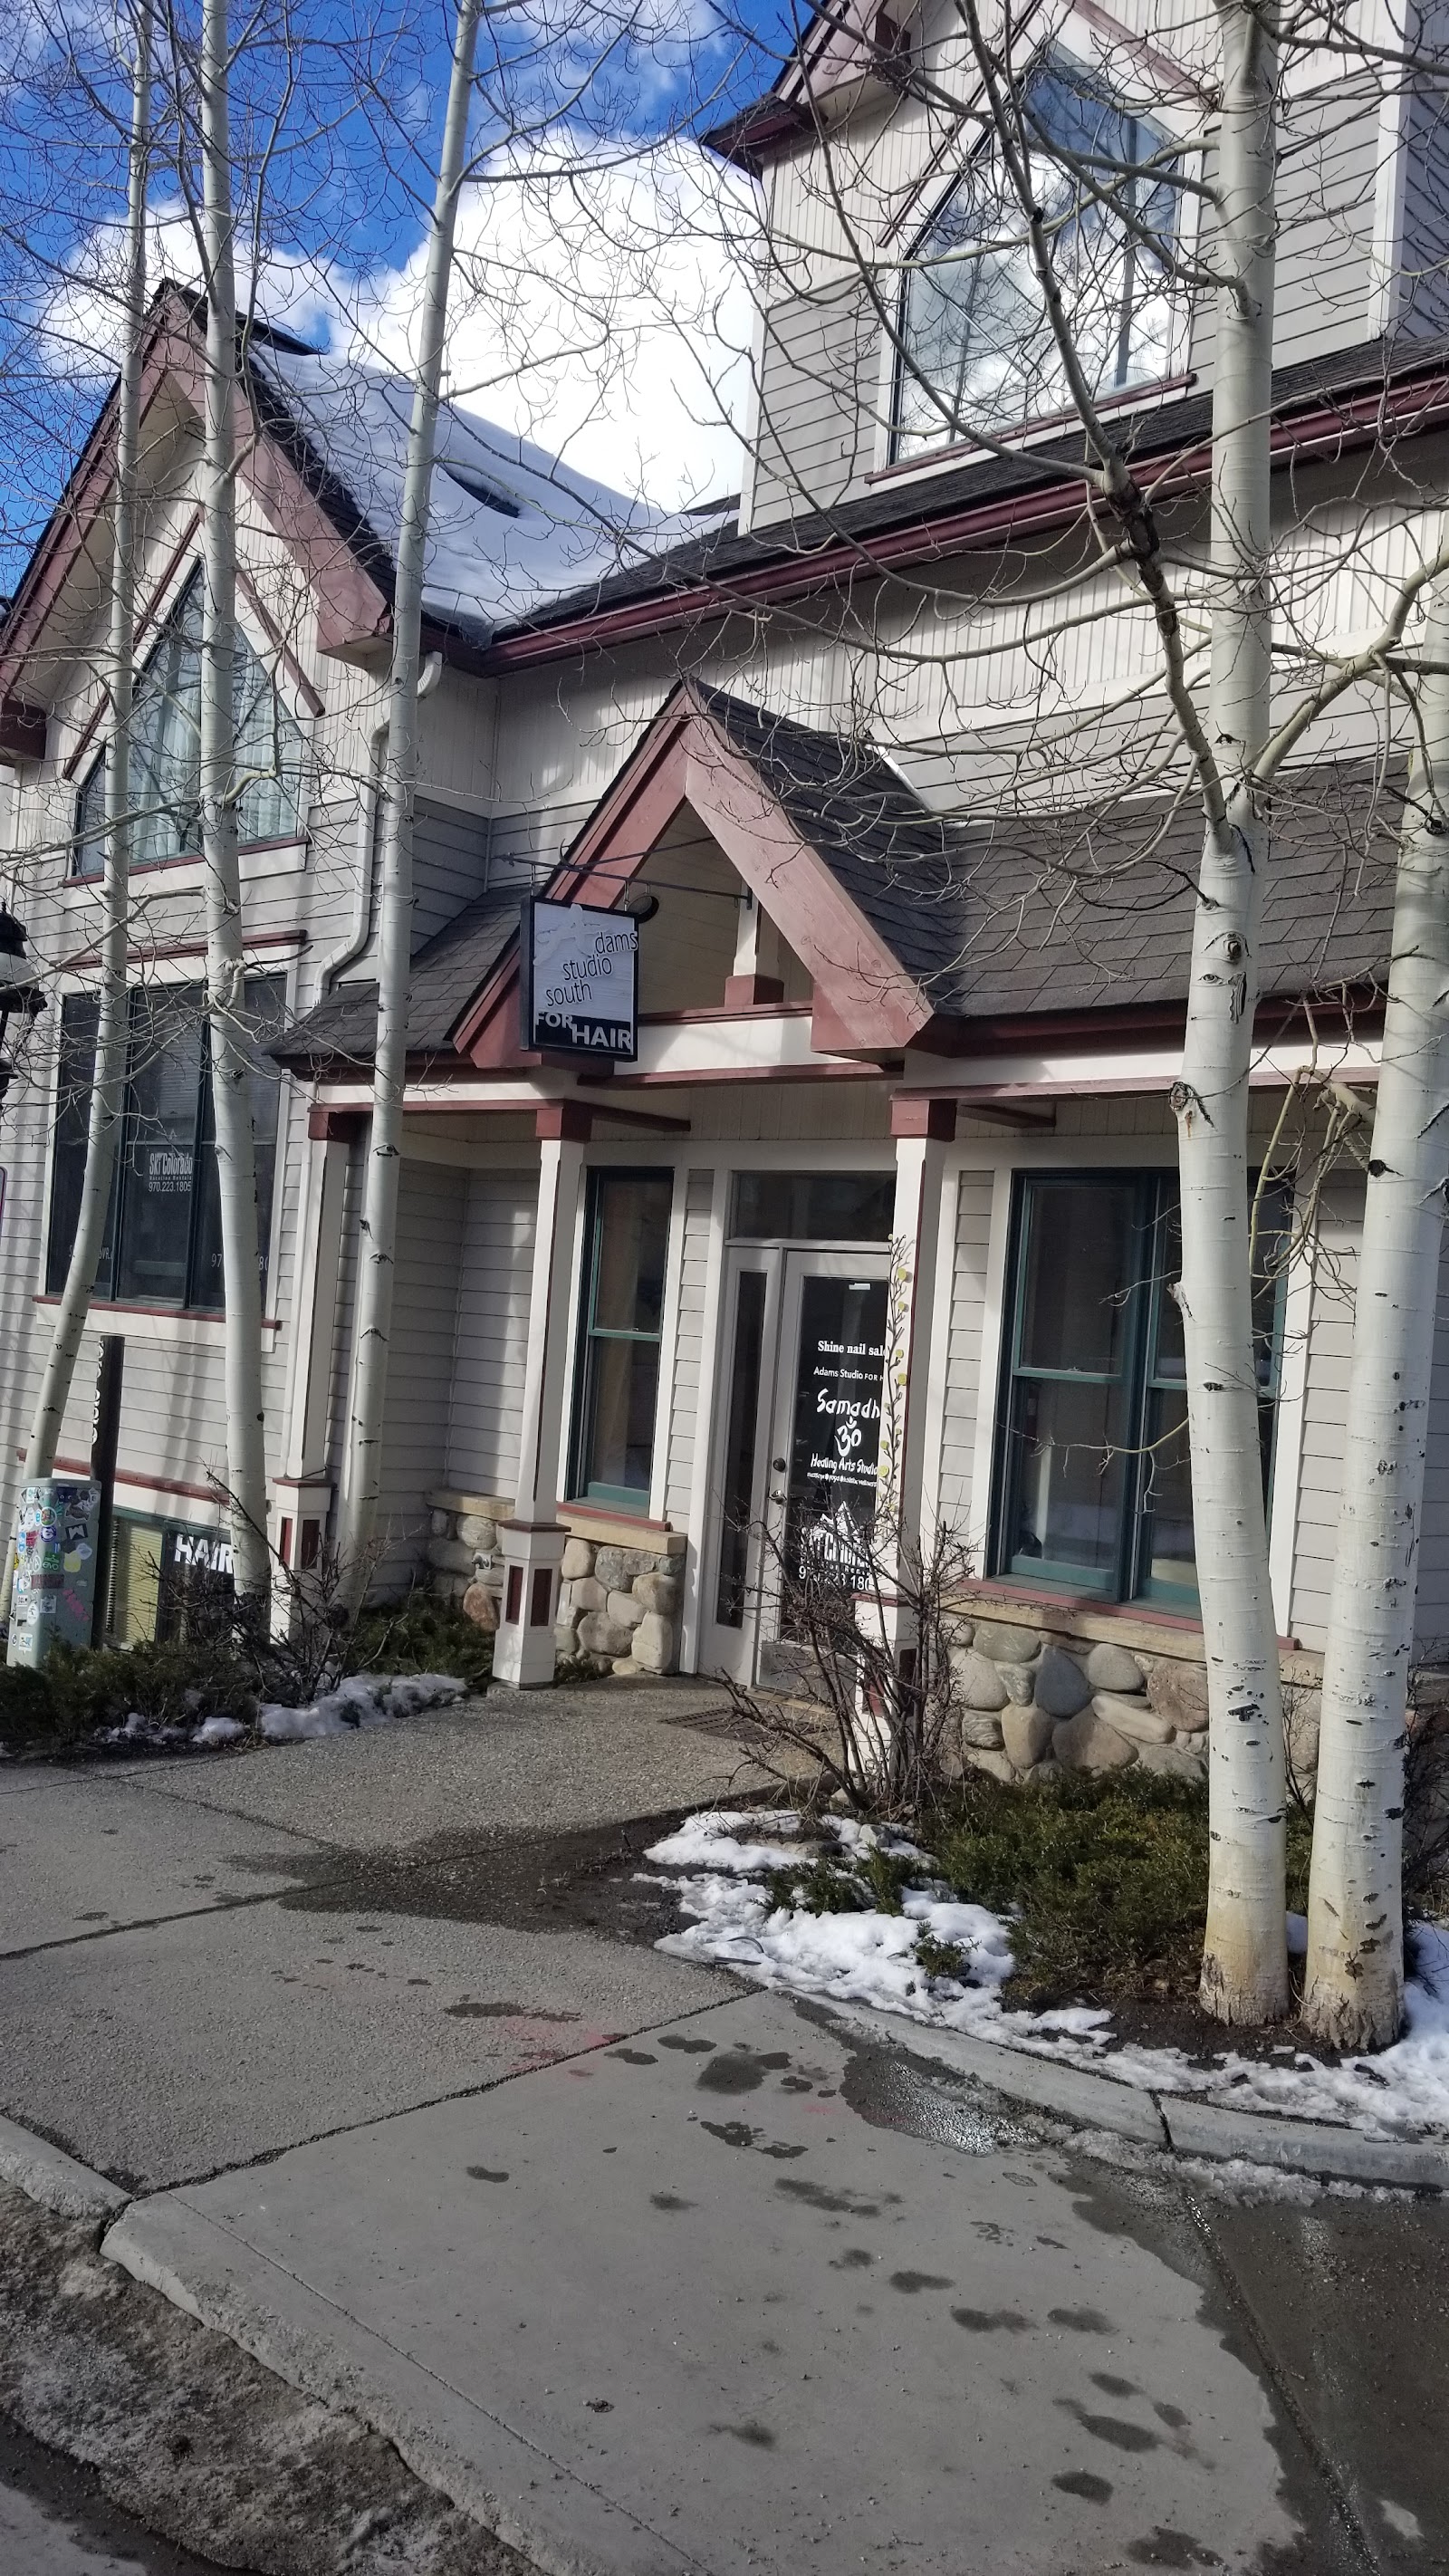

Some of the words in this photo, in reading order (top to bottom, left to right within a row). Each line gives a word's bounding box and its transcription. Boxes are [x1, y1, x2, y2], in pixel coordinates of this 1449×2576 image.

[563, 955, 612, 981] studio
[546, 981, 592, 1006] south
[536, 1012, 572, 1030] FOR
[571, 1023, 631, 1050] HAIR
[149, 1181, 192, 1192] 970.223.1805
[817, 1341, 845, 1353] Shine
[847, 1343, 867, 1355] nail
[813, 1366, 839, 1378] Adams
[840, 1369, 863, 1379] Studio
[864, 1373, 878, 1381] FOR
[811, 1453, 838, 1475] Healing
[839, 1456, 857, 1472] Arts
[175, 1533, 234, 1574] HAIR
